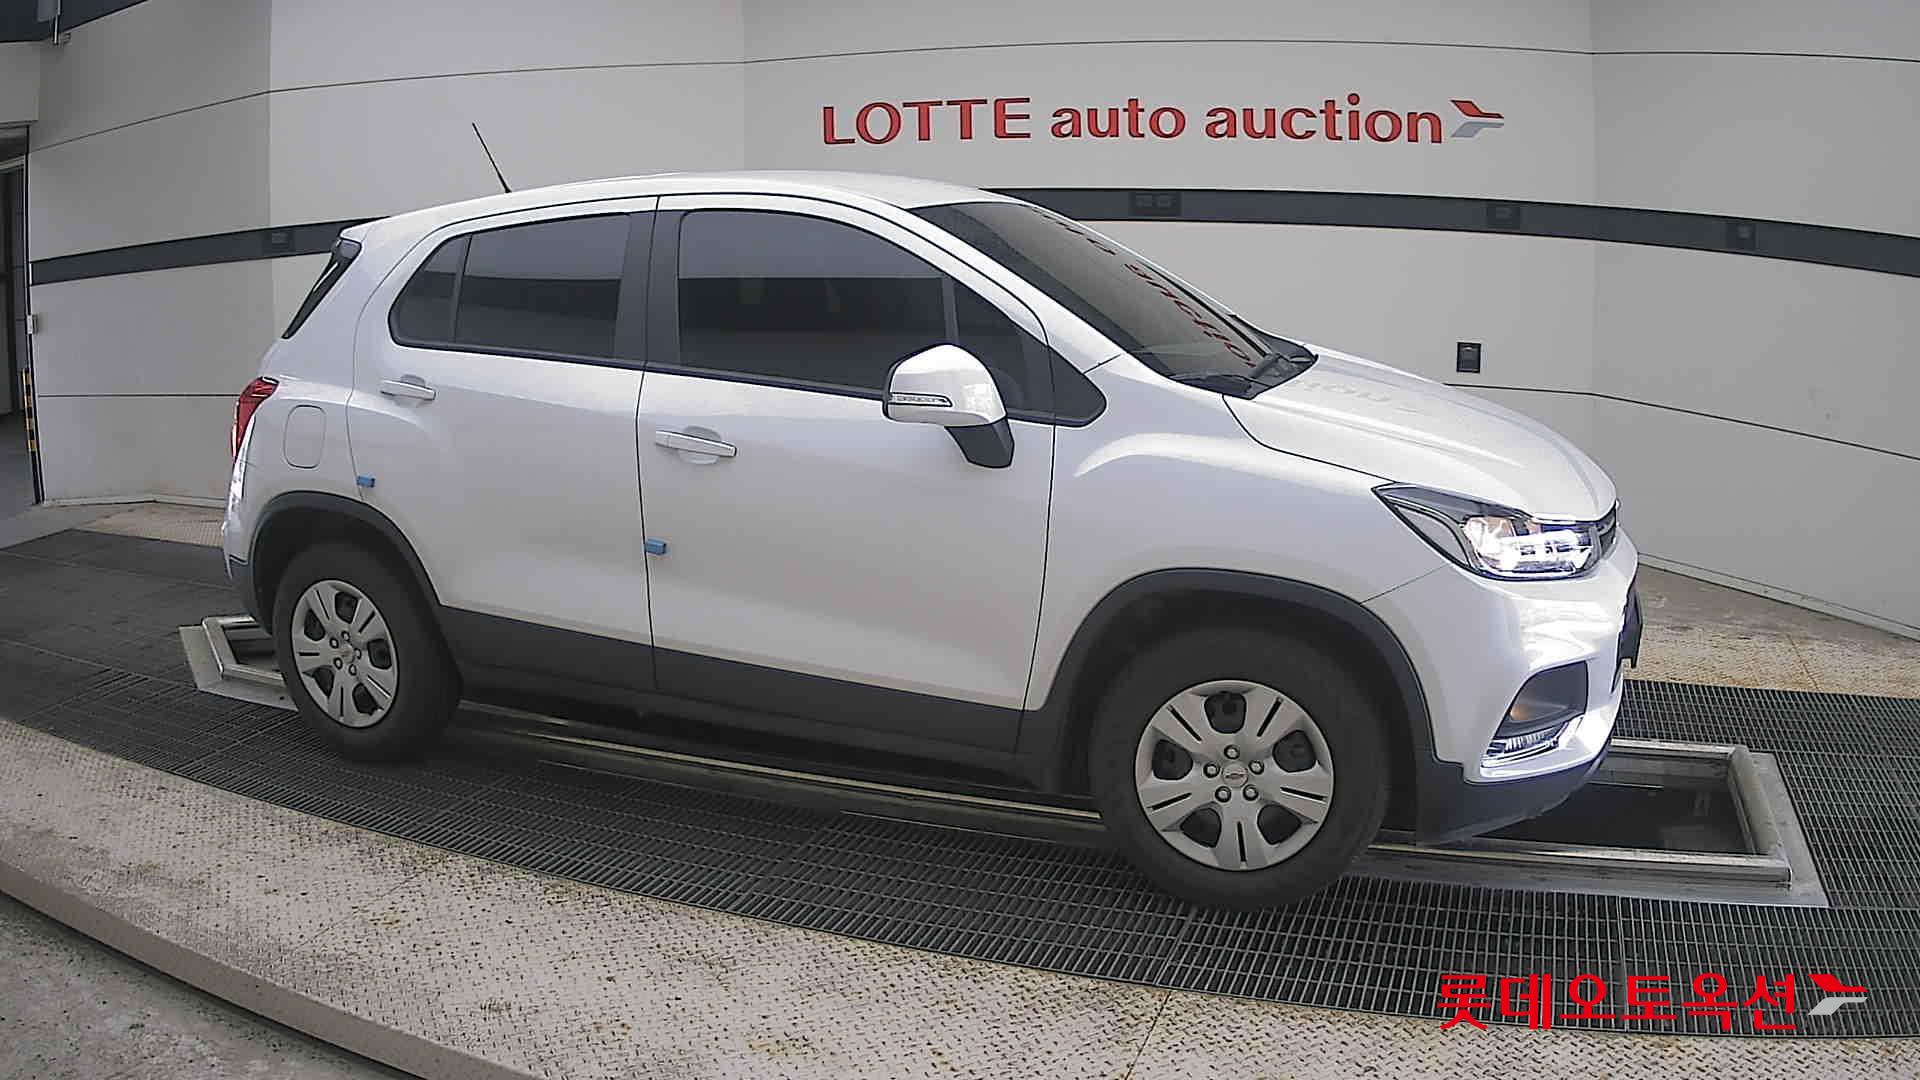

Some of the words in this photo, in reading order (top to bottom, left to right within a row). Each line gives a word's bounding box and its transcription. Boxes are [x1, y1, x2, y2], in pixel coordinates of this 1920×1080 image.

[822, 97, 1031, 145] LOTTE
[1050, 98, 1187, 139] auto
[1205, 94, 1443, 144] auction
